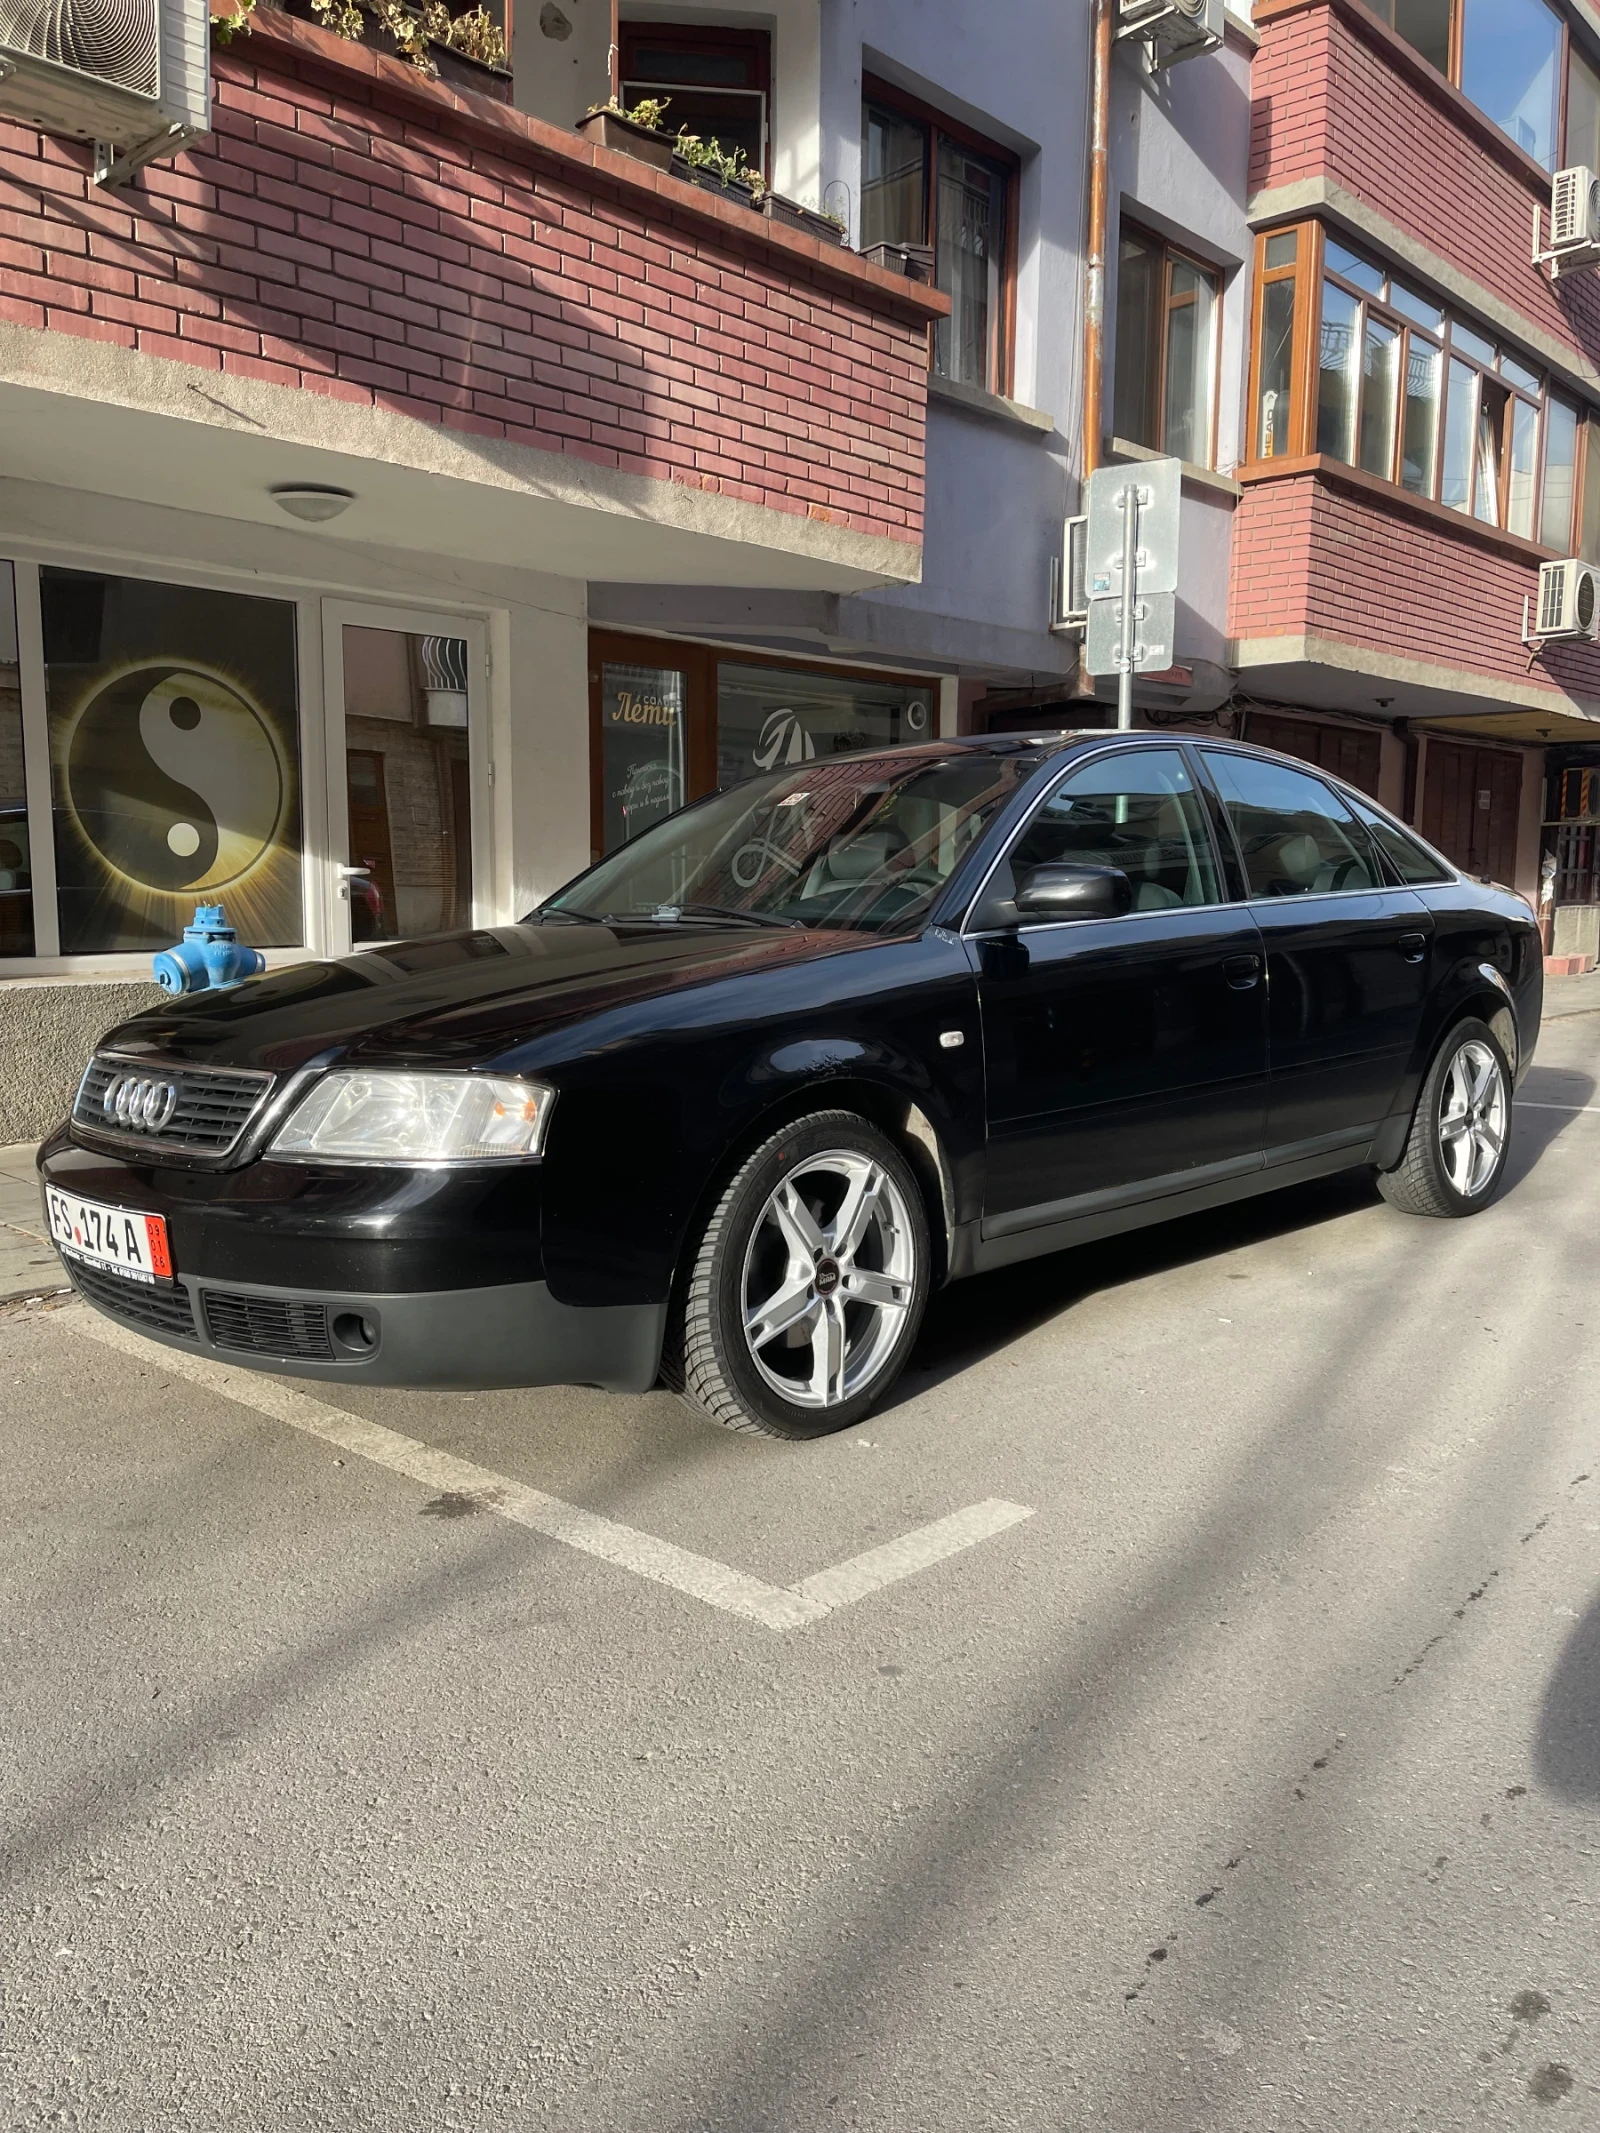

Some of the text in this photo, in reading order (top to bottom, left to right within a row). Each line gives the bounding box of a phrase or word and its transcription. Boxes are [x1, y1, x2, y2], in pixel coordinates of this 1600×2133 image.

[1264, 409, 1273, 456] HEAD
[50, 1194, 73, 1239] FS
[80, 1207, 119, 1257] 174
[124, 1218, 142, 1264] A
[148, 1223, 160, 1236] 09
[150, 1239, 163, 1252] 01
[153, 1255, 165, 1268] 26
